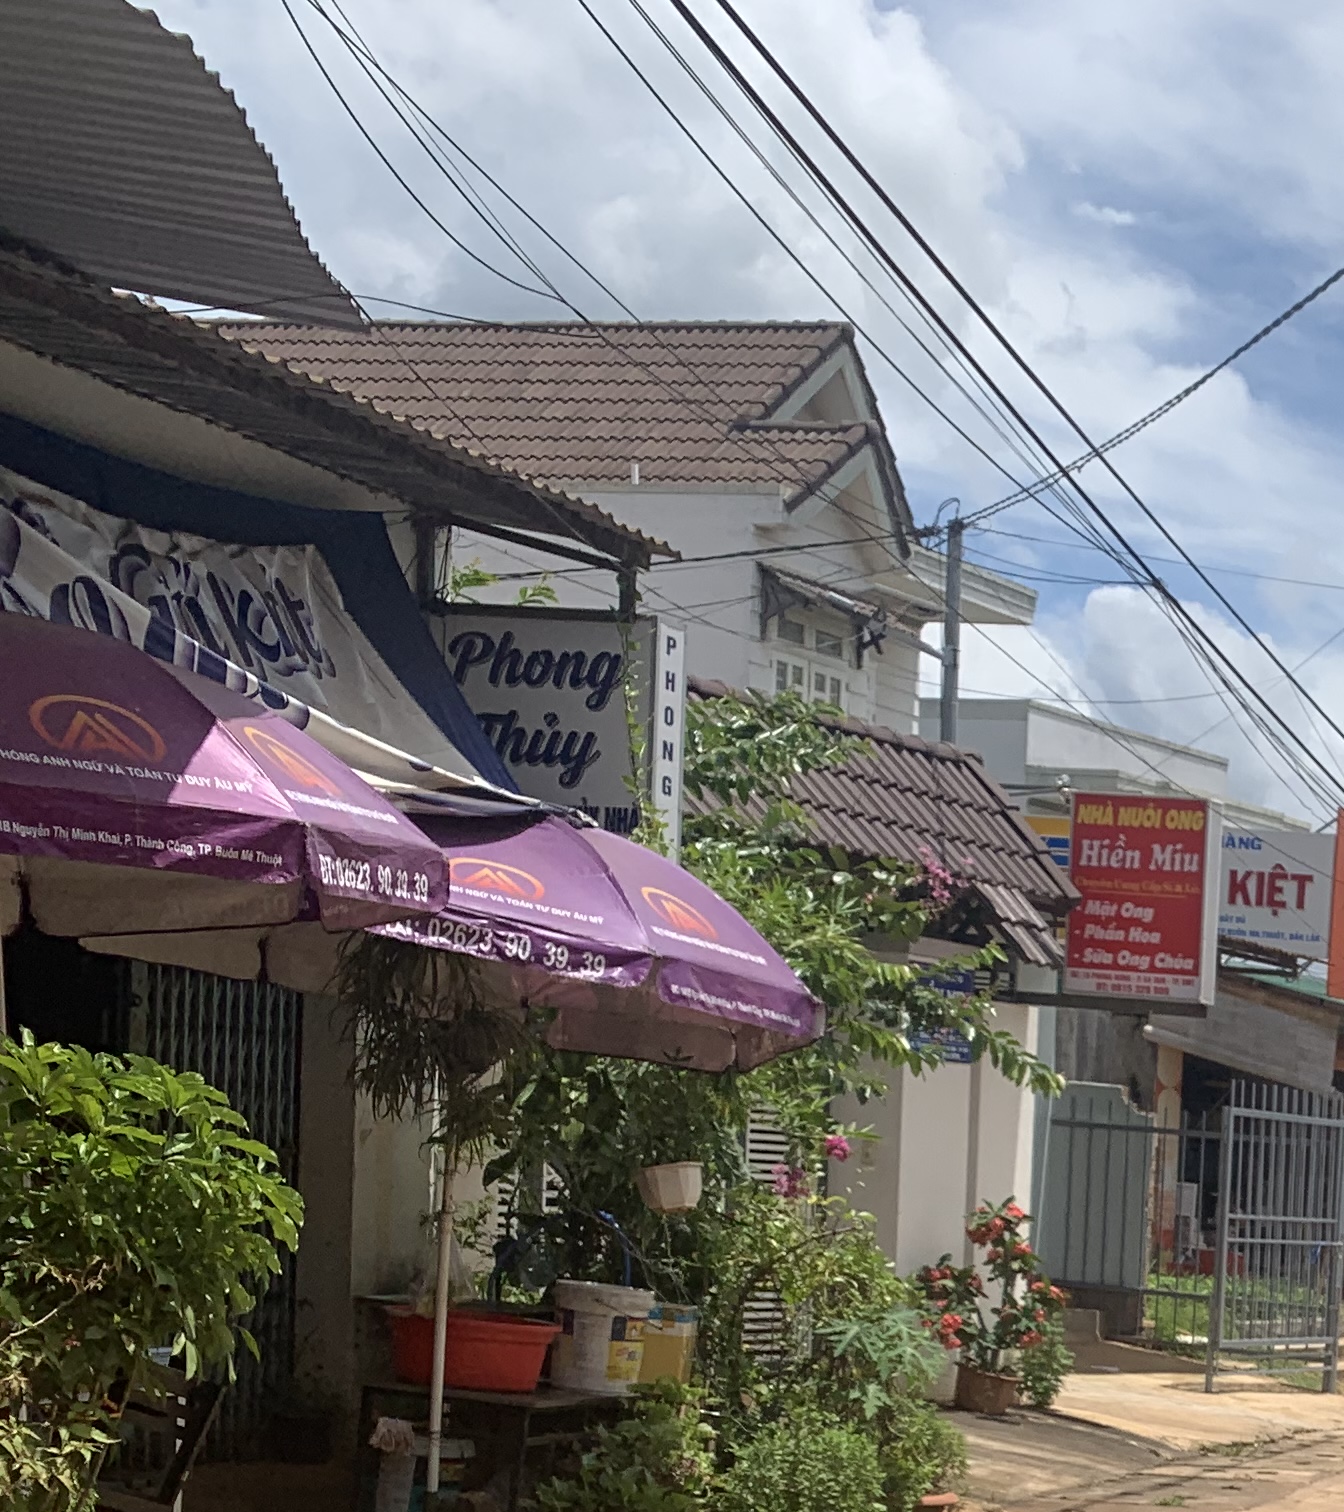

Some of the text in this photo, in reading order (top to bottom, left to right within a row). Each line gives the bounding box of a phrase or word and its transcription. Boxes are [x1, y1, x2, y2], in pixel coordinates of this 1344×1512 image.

[448, 631, 625, 711] Phong
[476, 709, 602, 789] Thủy
[42, 755, 72, 770] ANH
[104, 762, 126, 775] VÀ
[1077, 800, 1205, 831] NHÀ NUÔI ONG
[52, 826, 70, 843] Thị
[71, 827, 96, 842] Minh
[135, 835, 164, 850] Thành
[1078, 833, 1142, 869] Hiền
[413, 871, 429, 903] 39
[1228, 863, 1314, 917] KIỆT
[1120, 901, 1155, 923] Ong
[1127, 926, 1162, 945] Hoa
[581, 951, 606, 976] 39
[1117, 949, 1150, 971] Ong
[1154, 951, 1194, 971] Chúa
